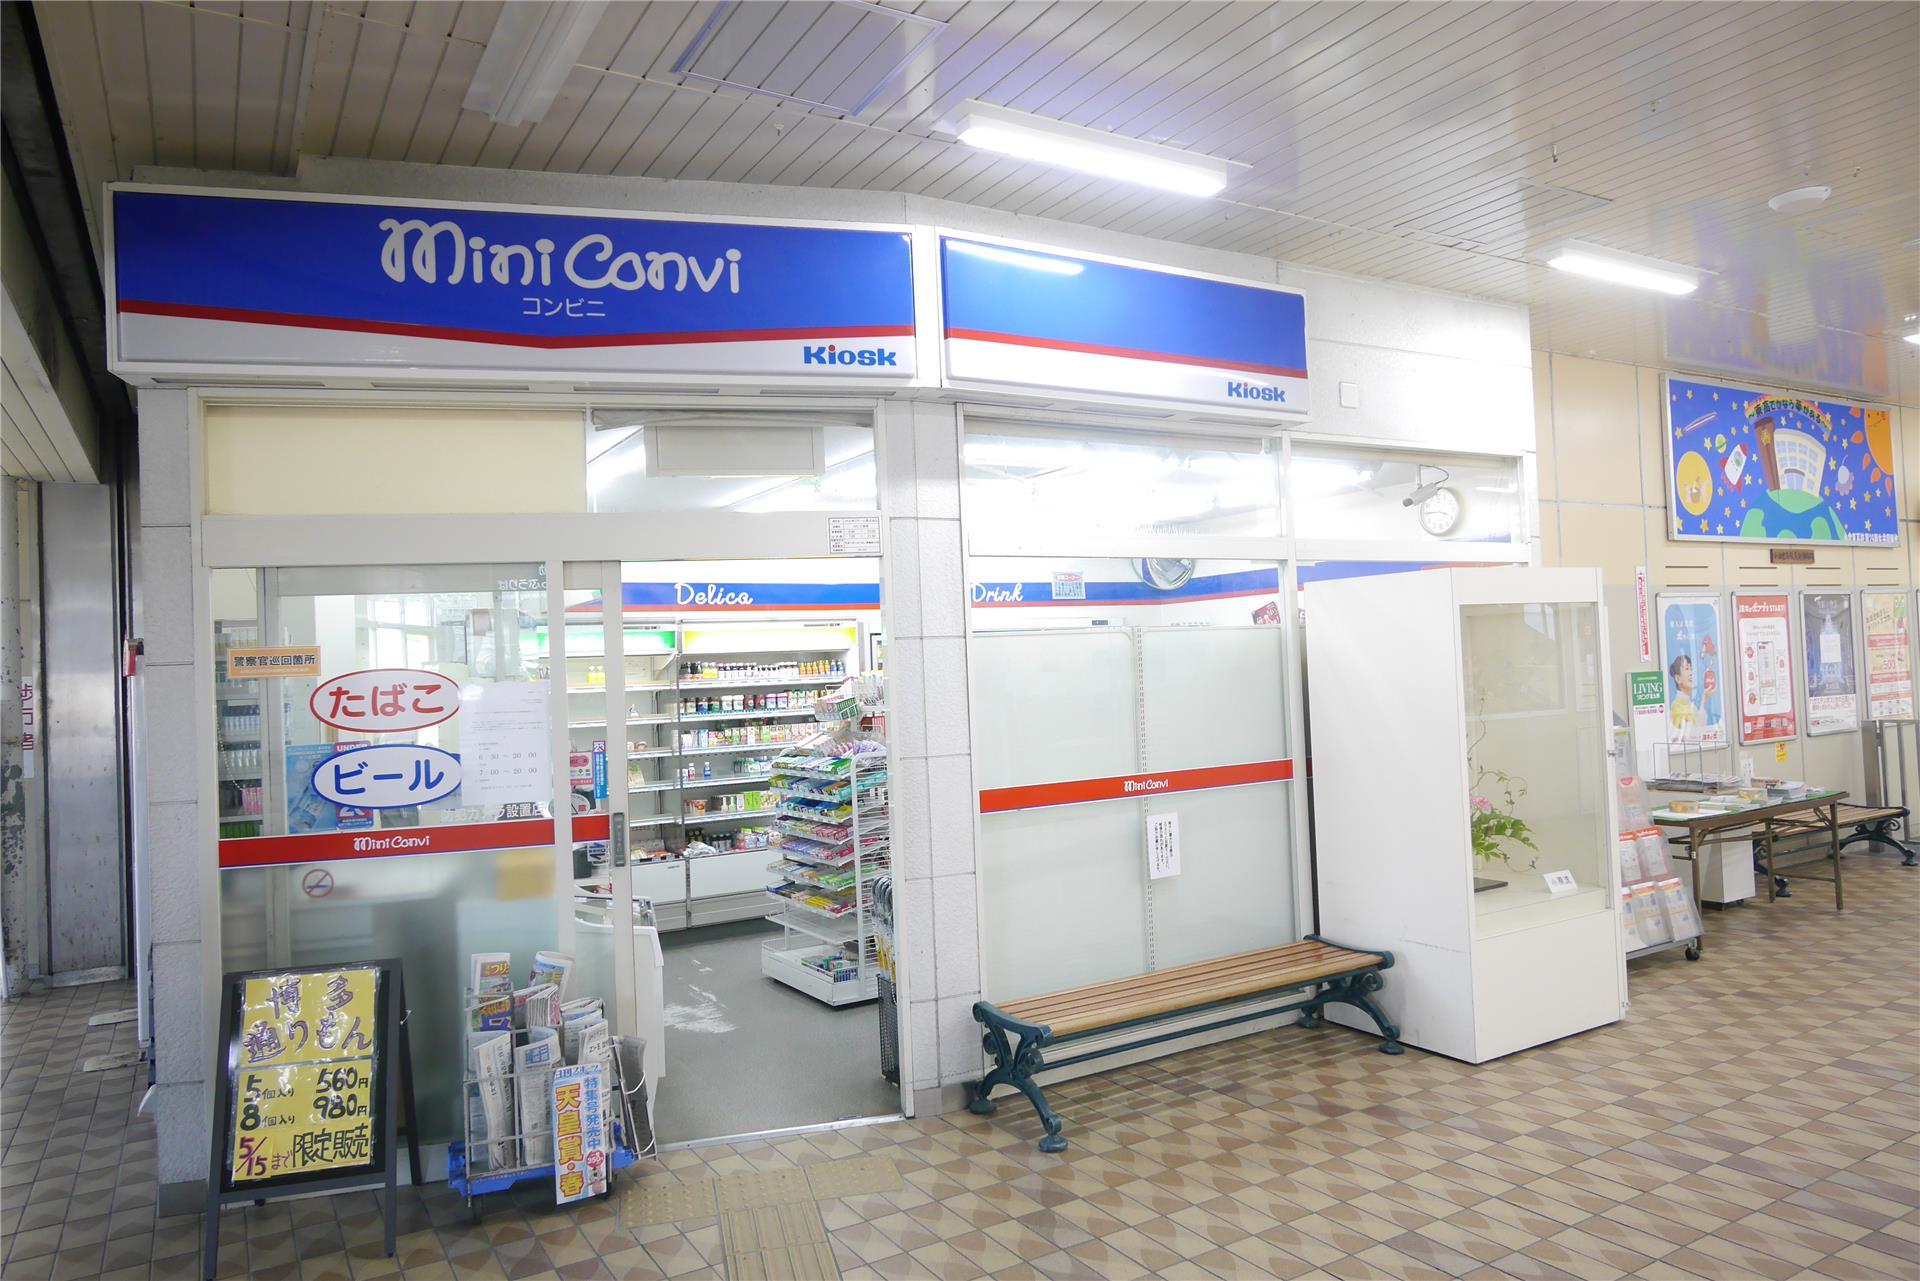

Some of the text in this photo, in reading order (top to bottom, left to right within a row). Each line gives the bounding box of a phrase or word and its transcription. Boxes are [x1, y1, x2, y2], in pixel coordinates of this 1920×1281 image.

[564, 233, 742, 295] Convi
[522, 296, 607, 318] コンビニ
[803, 344, 898, 368] Kiosk
[1226, 380, 1287, 403] Kiosk
[674, 582, 754, 606] Delica
[970, 582, 1024, 603] Drink
[233, 654, 316, 667] 警察官巡回箇所
[328, 682, 445, 719] たばこ
[1633, 681, 1663, 695] LIVING
[334, 759, 445, 795] ビール
[391, 834, 431, 850] Convi
[242, 1012, 373, 1064] 通りもん
[243, 1067, 369, 1103] 5個入り 560円
[240, 1094, 368, 1132] 8個入り 980円
[584, 1077, 602, 1151] 特集号発売中
[292, 1122, 369, 1168] 限定販売
[555, 1082, 585, 1198] 天皇賞・春
